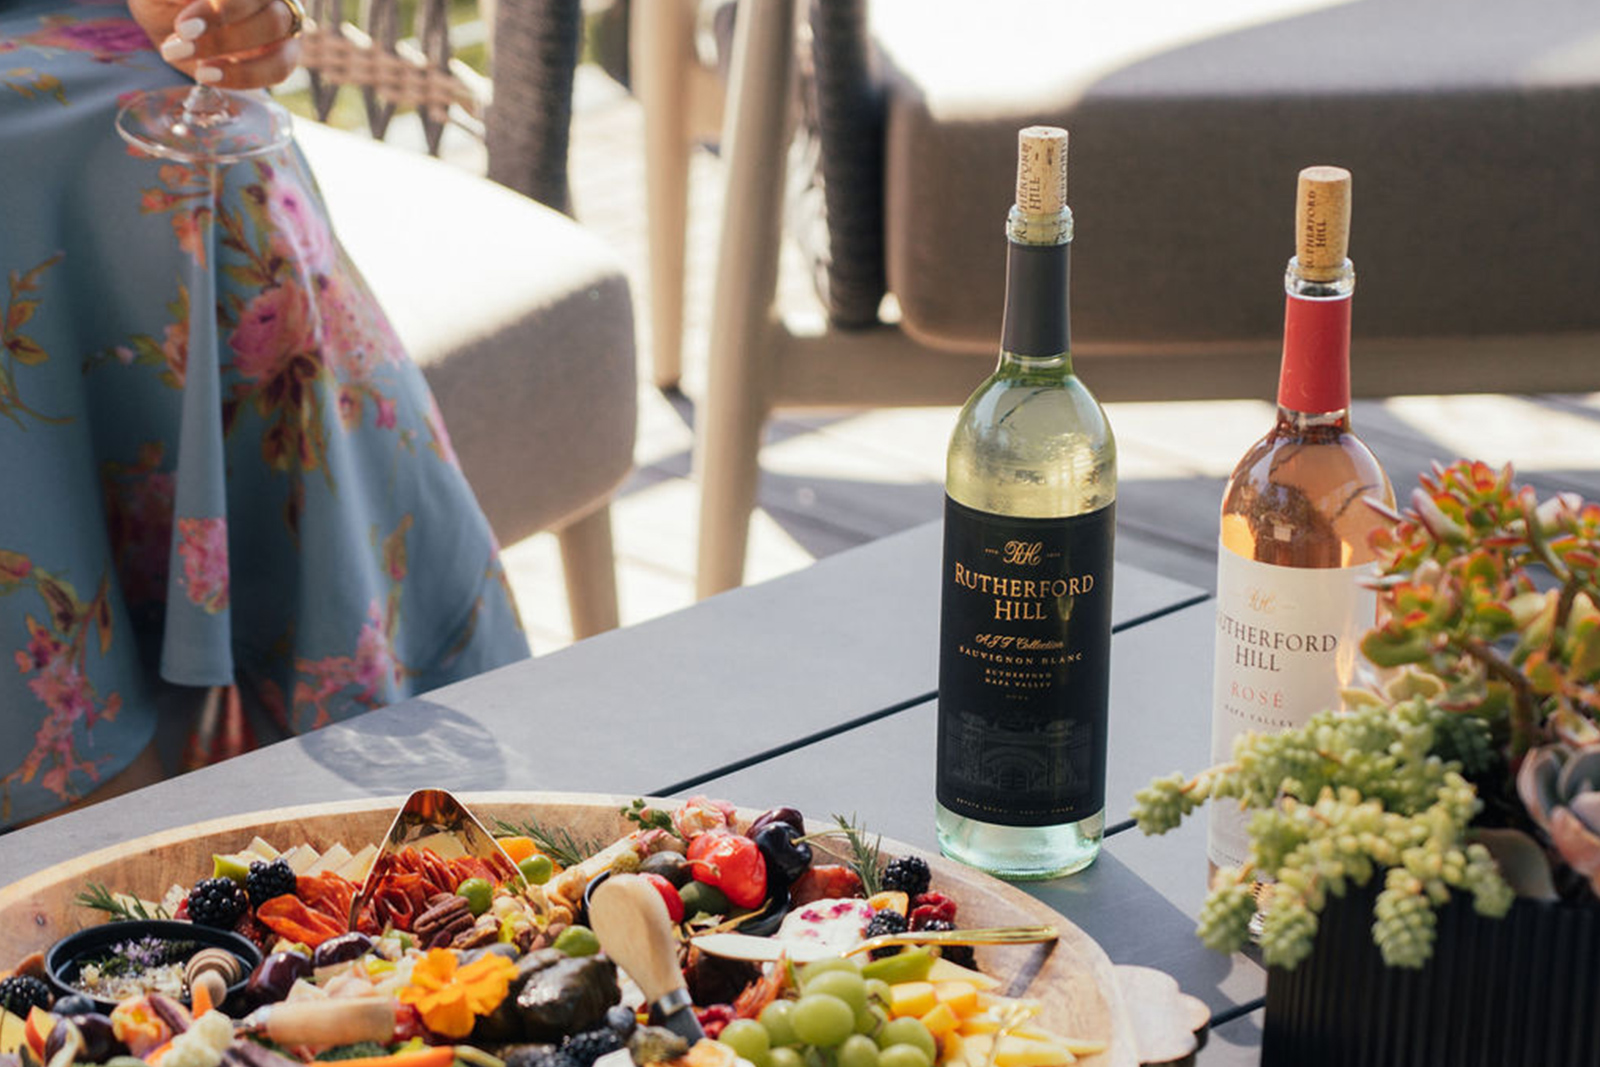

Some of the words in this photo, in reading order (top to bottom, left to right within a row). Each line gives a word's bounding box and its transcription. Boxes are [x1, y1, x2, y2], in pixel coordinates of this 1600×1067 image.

[1029, 177, 1041, 210] HILL
[1316, 219, 1327, 247] HILL
[955, 561, 1095, 598] RUTHERFORD
[994, 599, 1048, 621] HILL
[958, 645, 1033, 665] SAUVIGNON
[1041, 652, 1083, 665] BLANC
[1235, 644, 1281, 673] HILL
